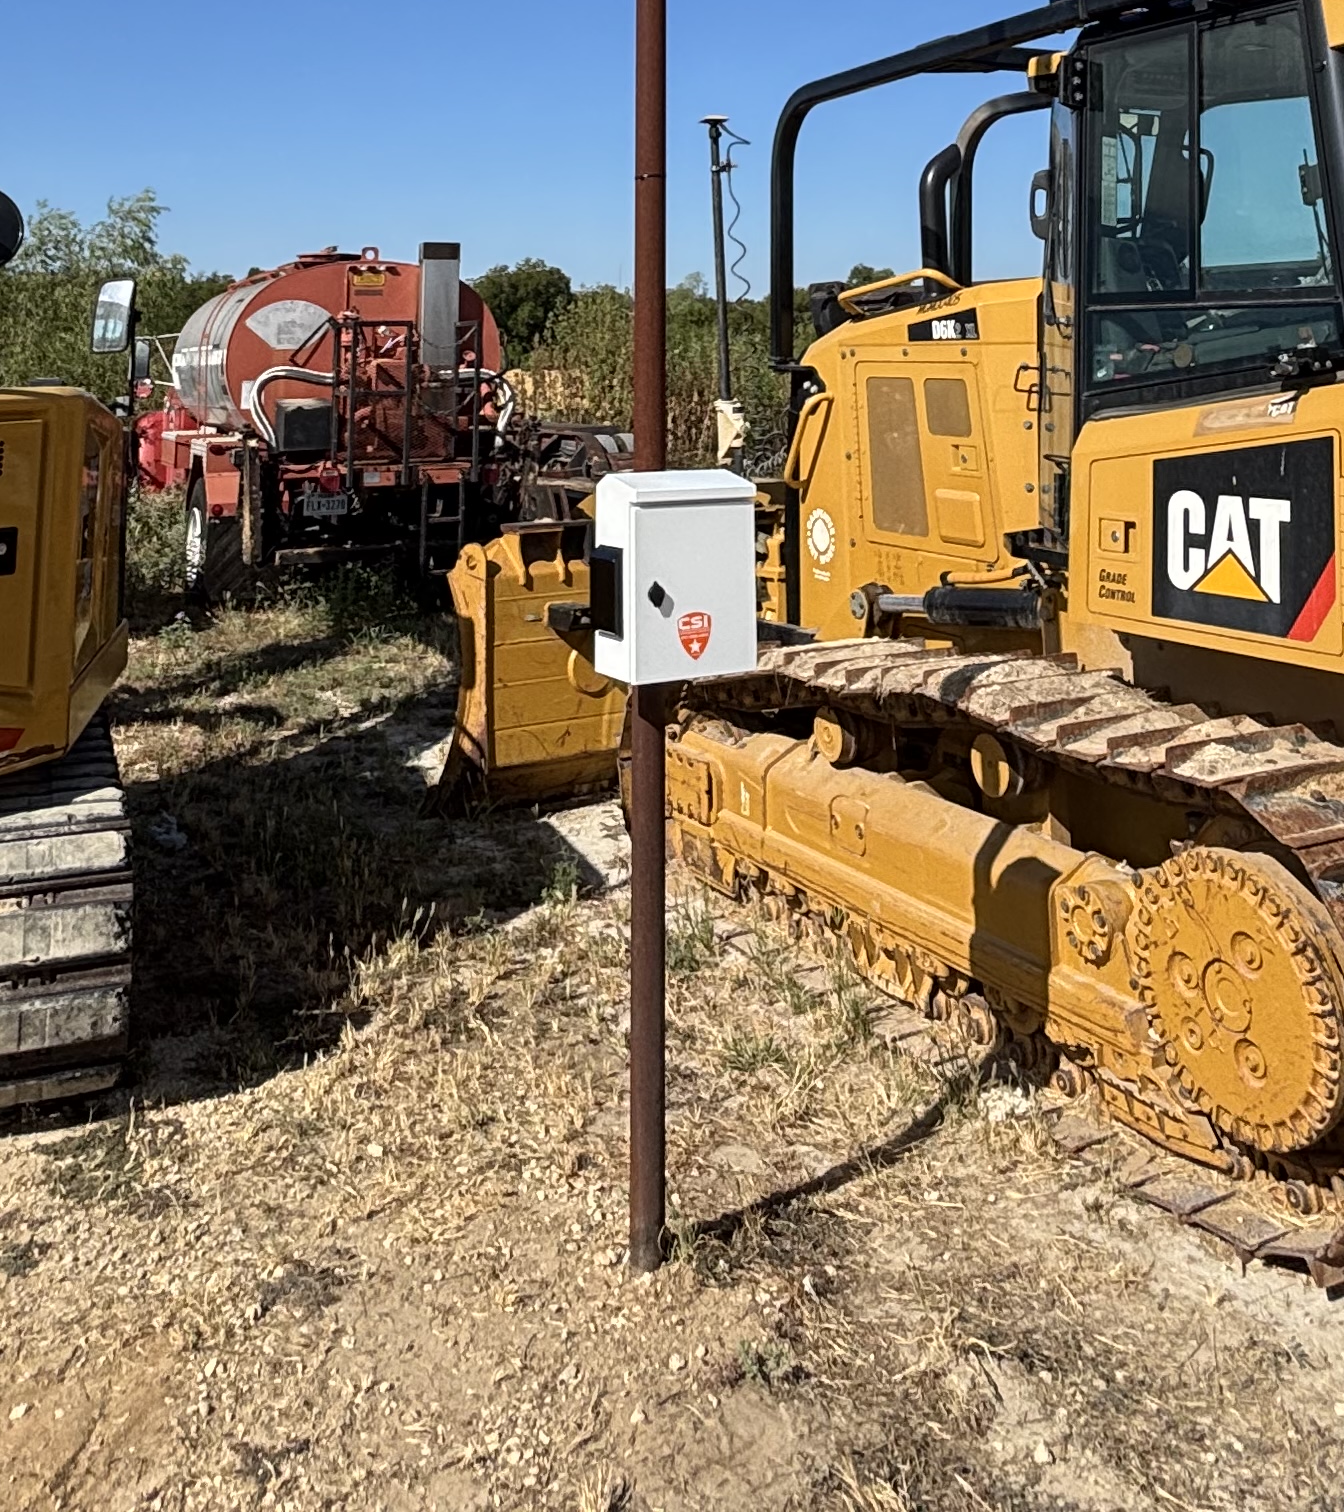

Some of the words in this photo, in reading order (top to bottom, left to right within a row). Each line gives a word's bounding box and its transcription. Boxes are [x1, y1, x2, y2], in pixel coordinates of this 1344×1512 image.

[1167, 489, 1291, 604] CAT
[1099, 584, 1136, 603] CONTROL
[678, 614, 709, 630] CSI
